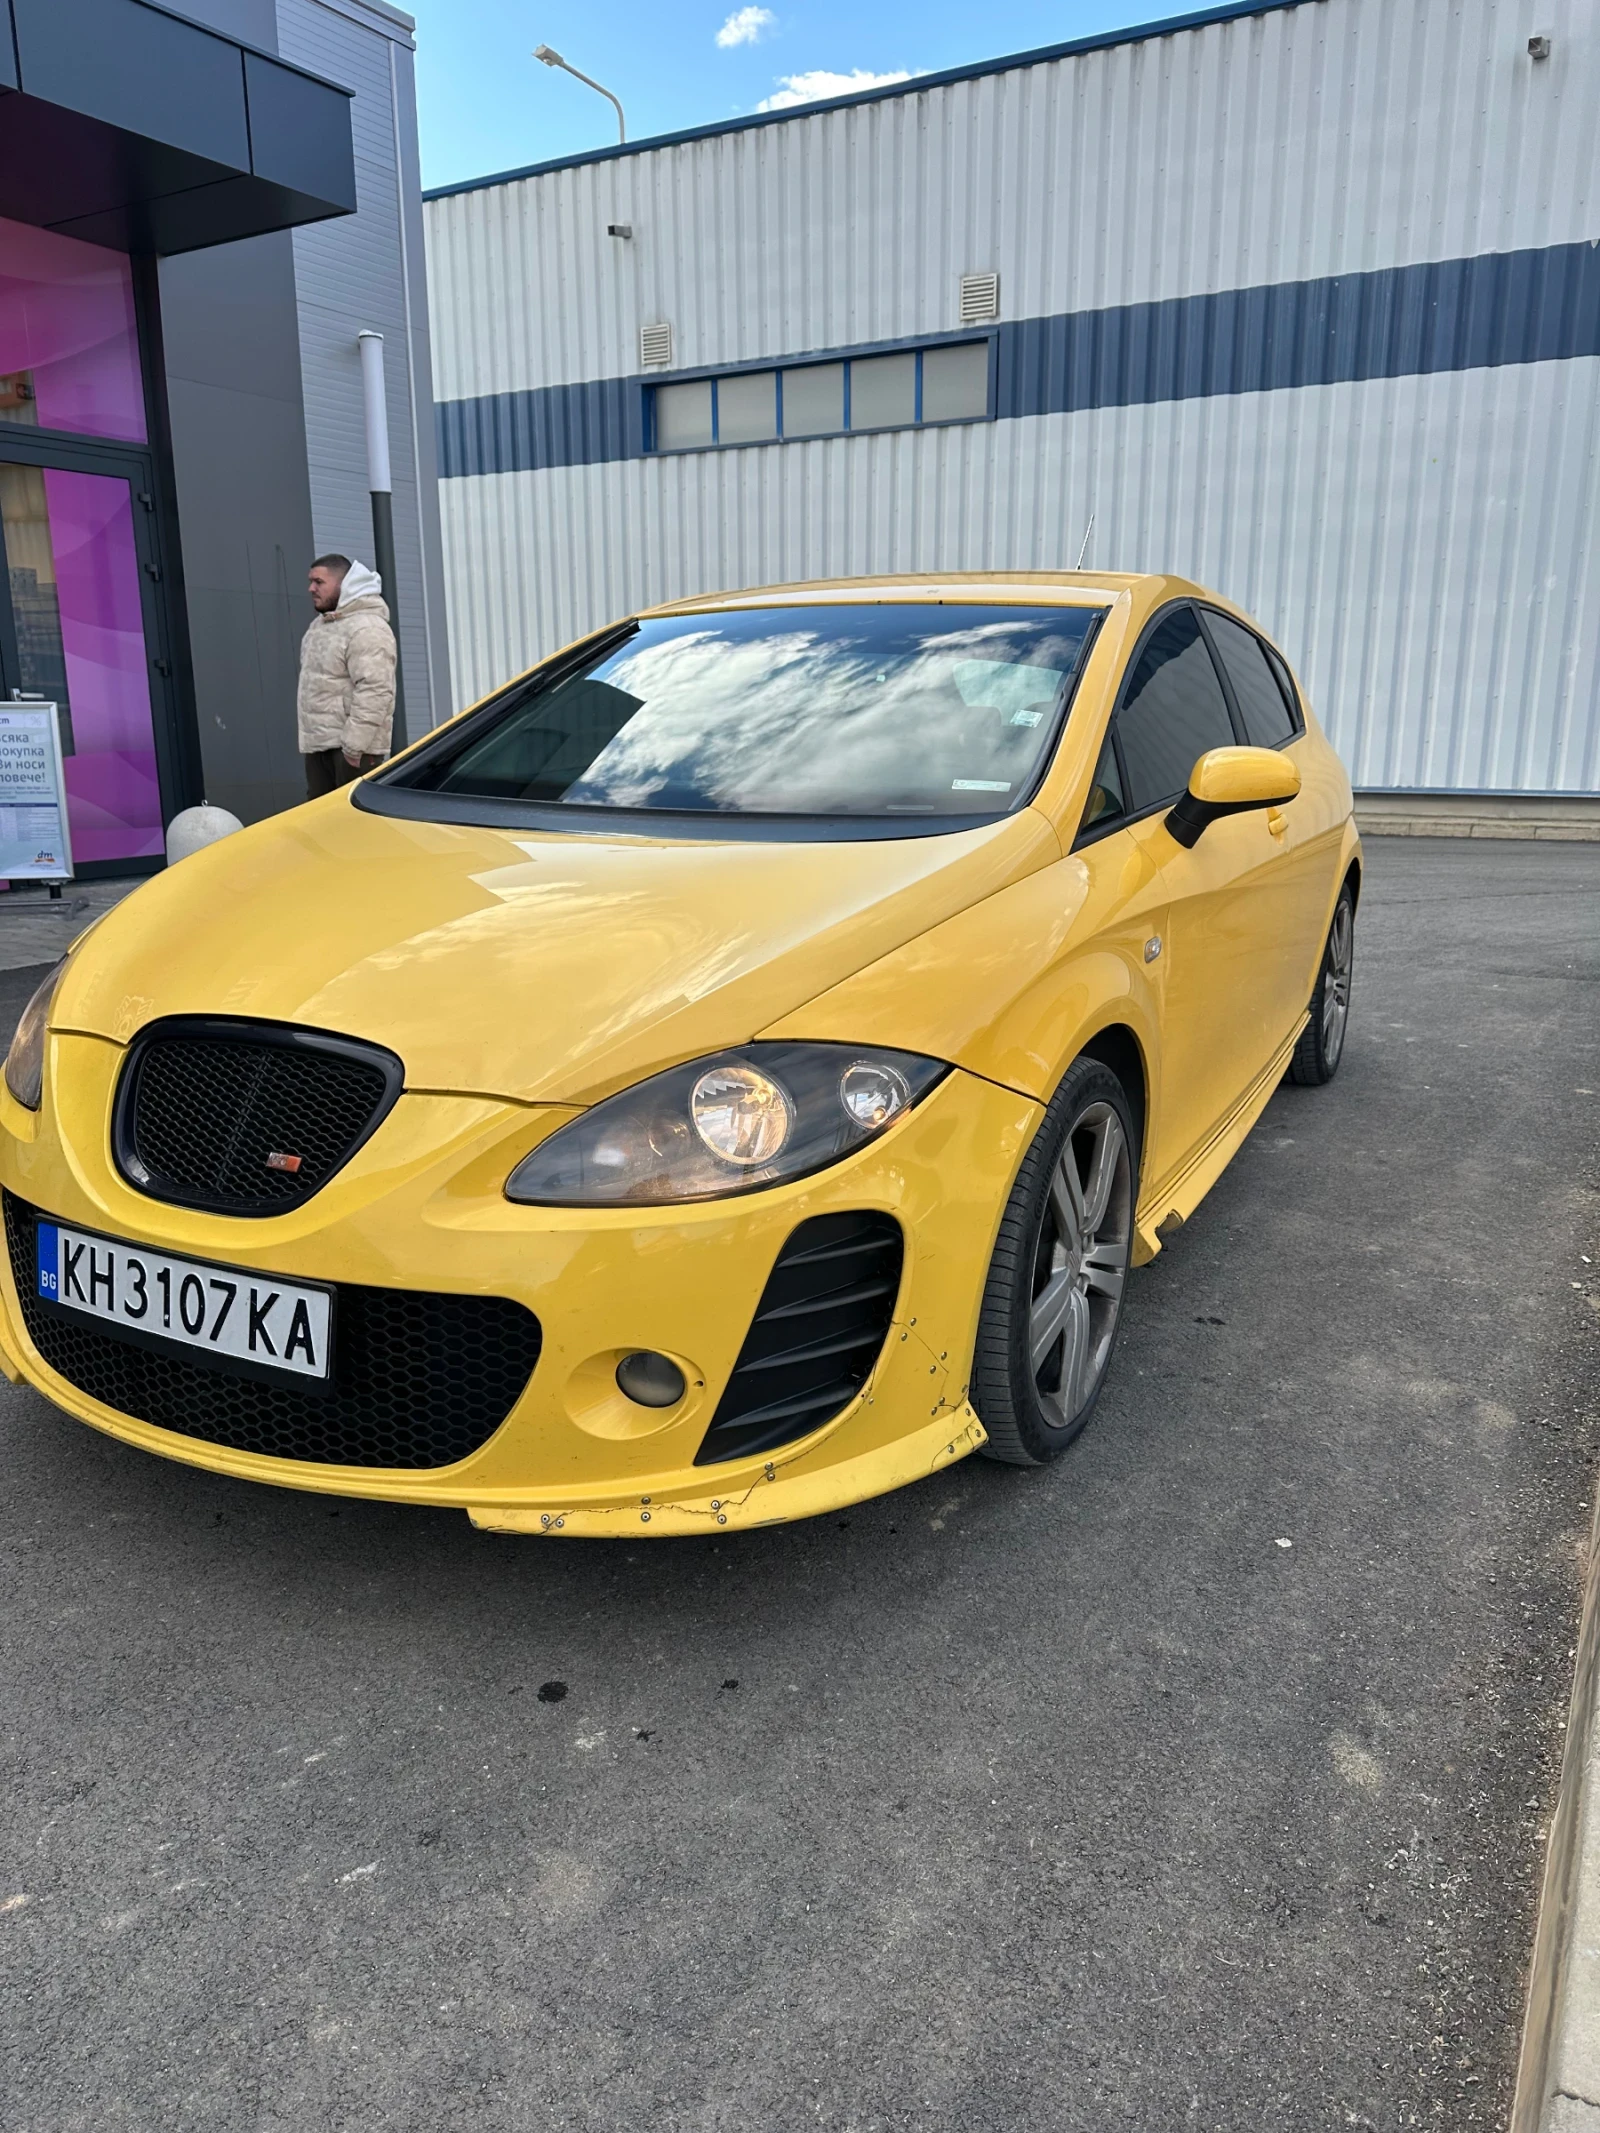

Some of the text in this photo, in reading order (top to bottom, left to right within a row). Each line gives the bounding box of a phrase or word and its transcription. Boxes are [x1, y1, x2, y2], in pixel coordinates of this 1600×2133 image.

[0, 734, 29, 743] сяка
[0, 747, 45, 759] окупка
[16, 760, 46, 770] носи
[37, 849, 53, 859] dm
[41, 1269, 57, 1290] BG
